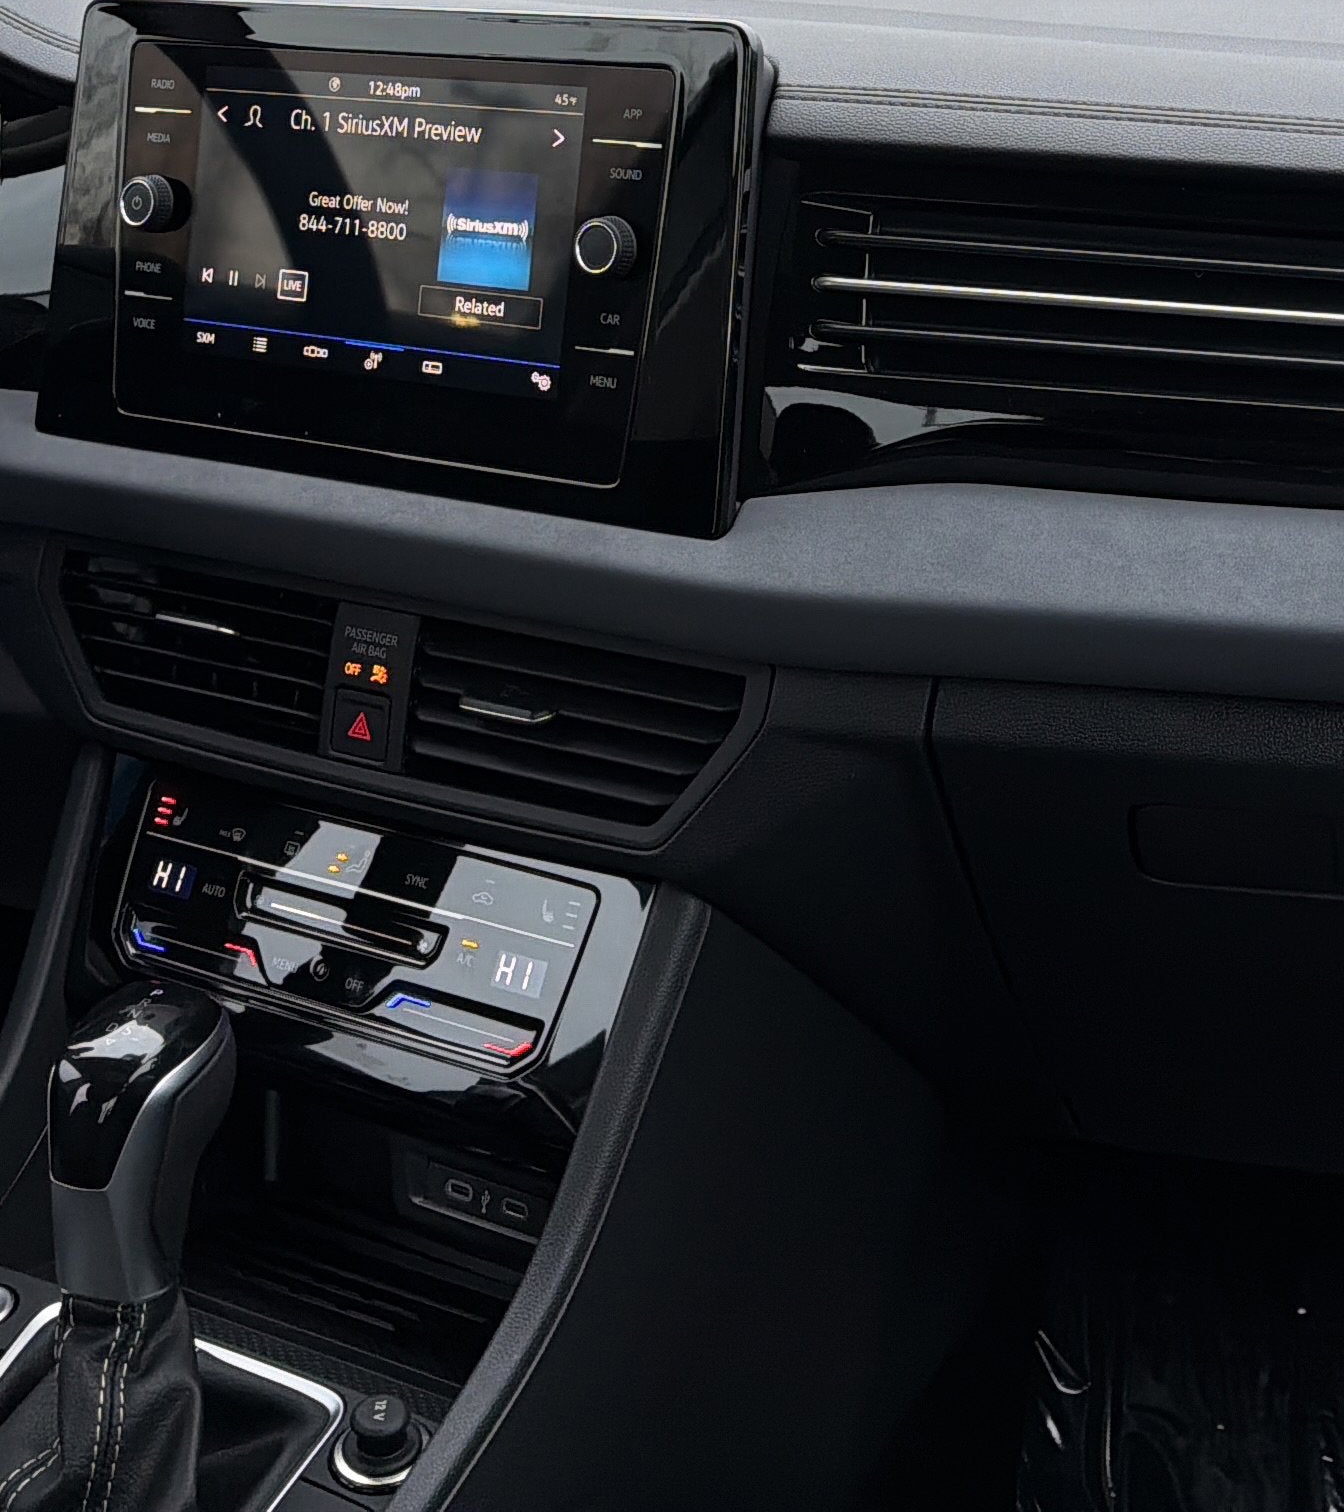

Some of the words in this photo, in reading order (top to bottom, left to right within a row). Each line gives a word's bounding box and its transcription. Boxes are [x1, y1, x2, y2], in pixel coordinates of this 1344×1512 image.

[150, 77, 175, 90] RADIO
[368, 80, 421, 100] 12:48pm
[622, 108, 643, 120] APP
[290, 108, 316, 131] Ch.
[322, 111, 331, 131] 1
[336, 111, 408, 138] SiriusXM
[413, 117, 483, 144] Preview
[146, 131, 171, 144] MEDIA
[608, 167, 643, 181] SOUND
[308, 191, 340, 210] Great
[342, 193, 374, 212] Offer
[375, 197, 410, 216] Now!
[298, 213, 407, 241] 844-711-8800
[135, 260, 162, 274] PHONE
[282, 279, 303, 292] LIVE
[454, 295, 505, 317] Related
[132, 316, 156, 330] VOICE
[599, 312, 620, 326] CAR
[195, 331, 215, 344] SXM
[589, 374, 618, 389] MENU
[343, 625, 399, 648] PASSENGER
[351, 641, 367, 655] AIR
[367, 644, 387, 660] BAG
[343, 661, 363, 676] OFF
[404, 872, 431, 890] SYNC
[201, 882, 227, 899] AUTO
[456, 952, 476, 968] A/C
[343, 976, 365, 991] OFF
